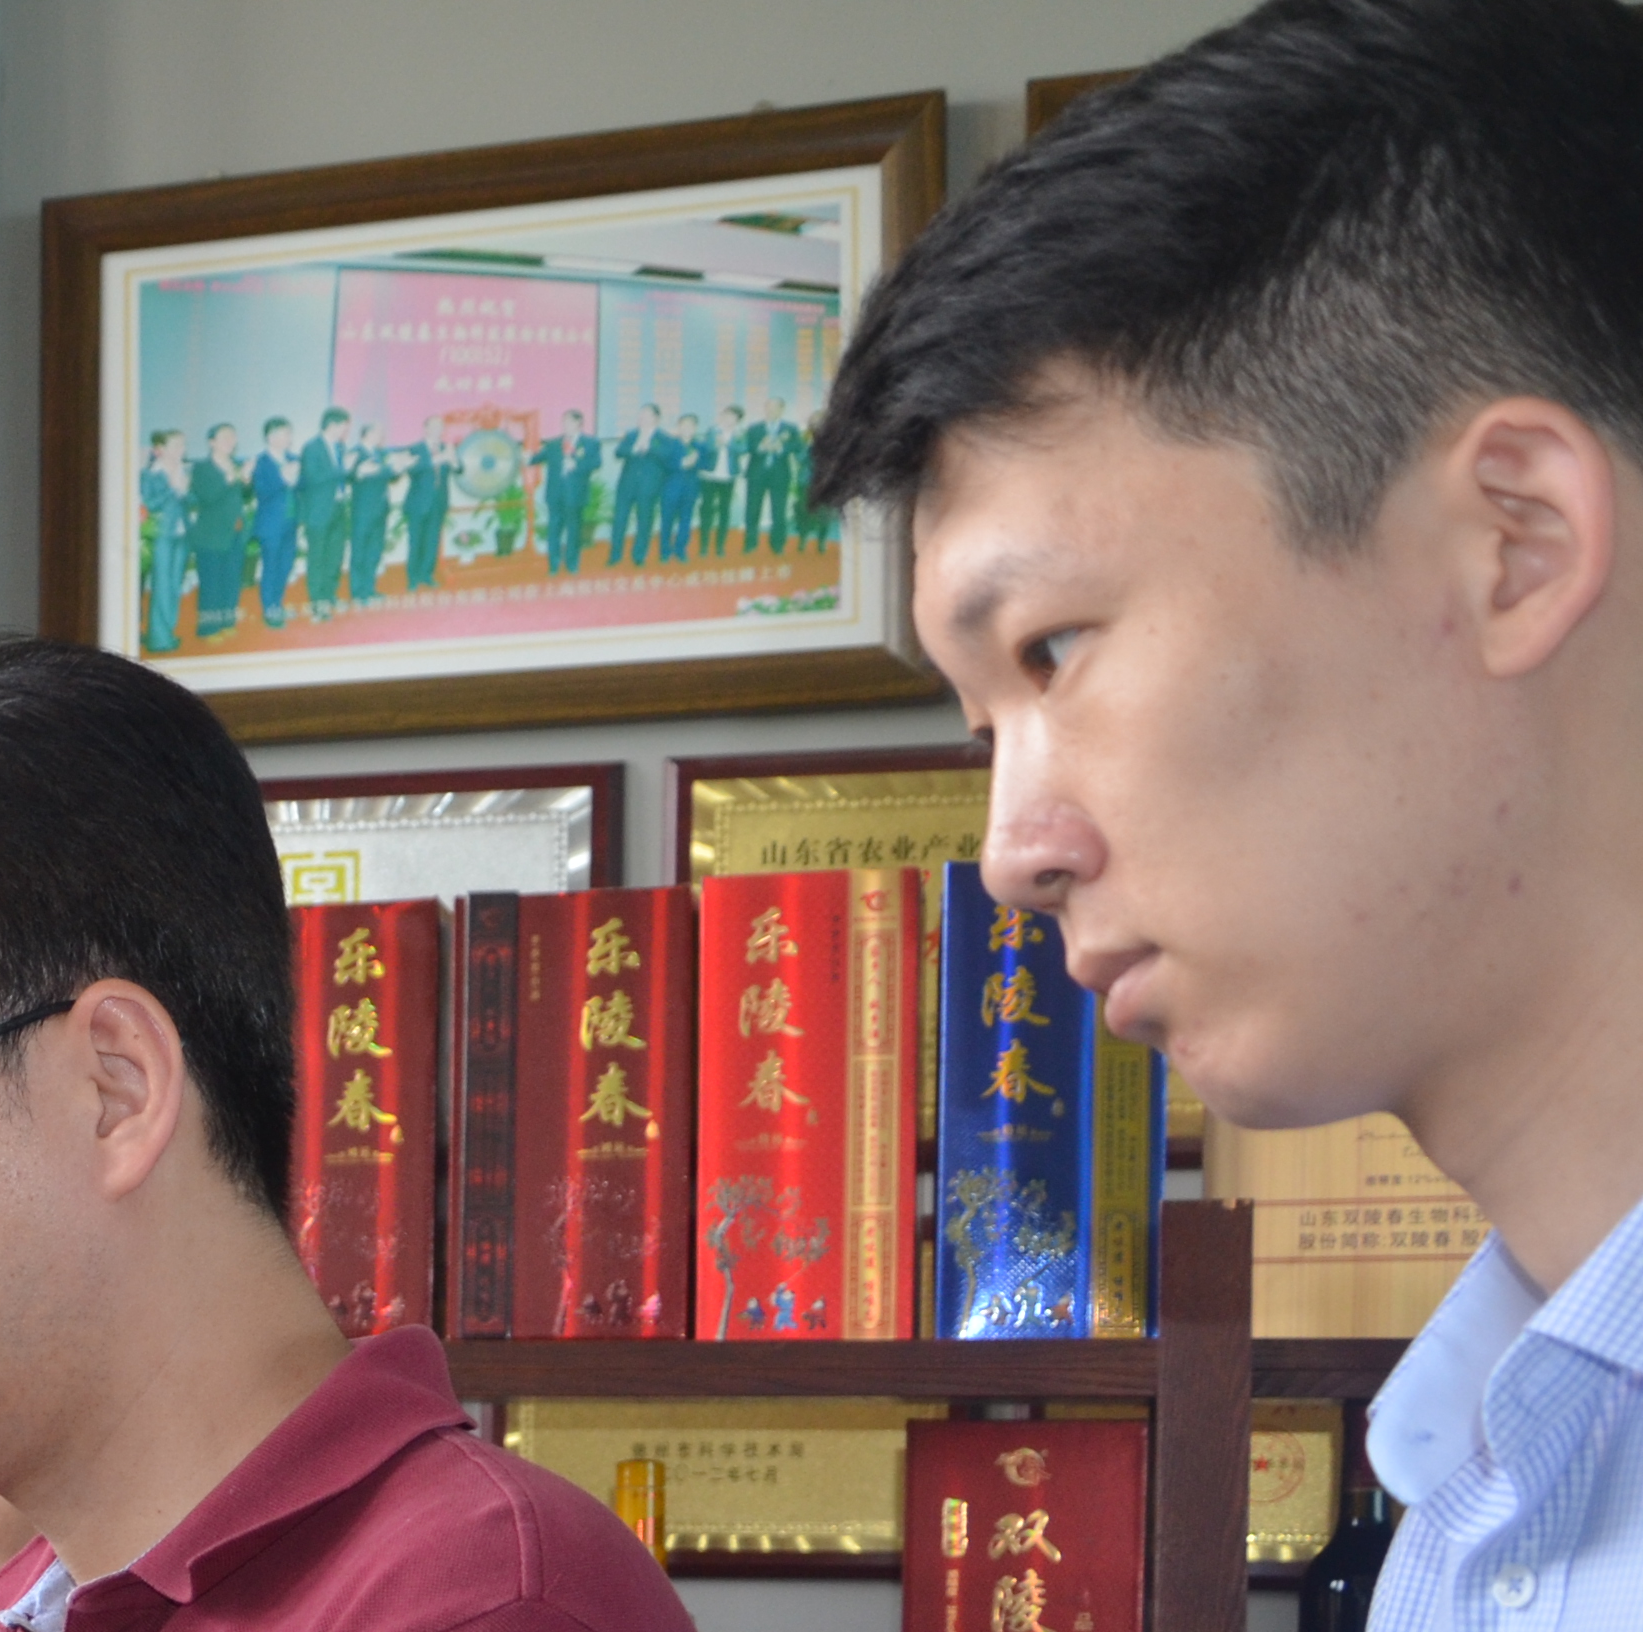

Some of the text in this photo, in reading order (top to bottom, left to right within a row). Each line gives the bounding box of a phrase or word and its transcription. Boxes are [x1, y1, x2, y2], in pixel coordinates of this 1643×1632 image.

[326, 927, 398, 1132] 乐陵春
[578, 917, 653, 1127] 乐陵春
[739, 906, 811, 1113] 乐陵春
[980, 904, 1057, 1104] 乐陵春
